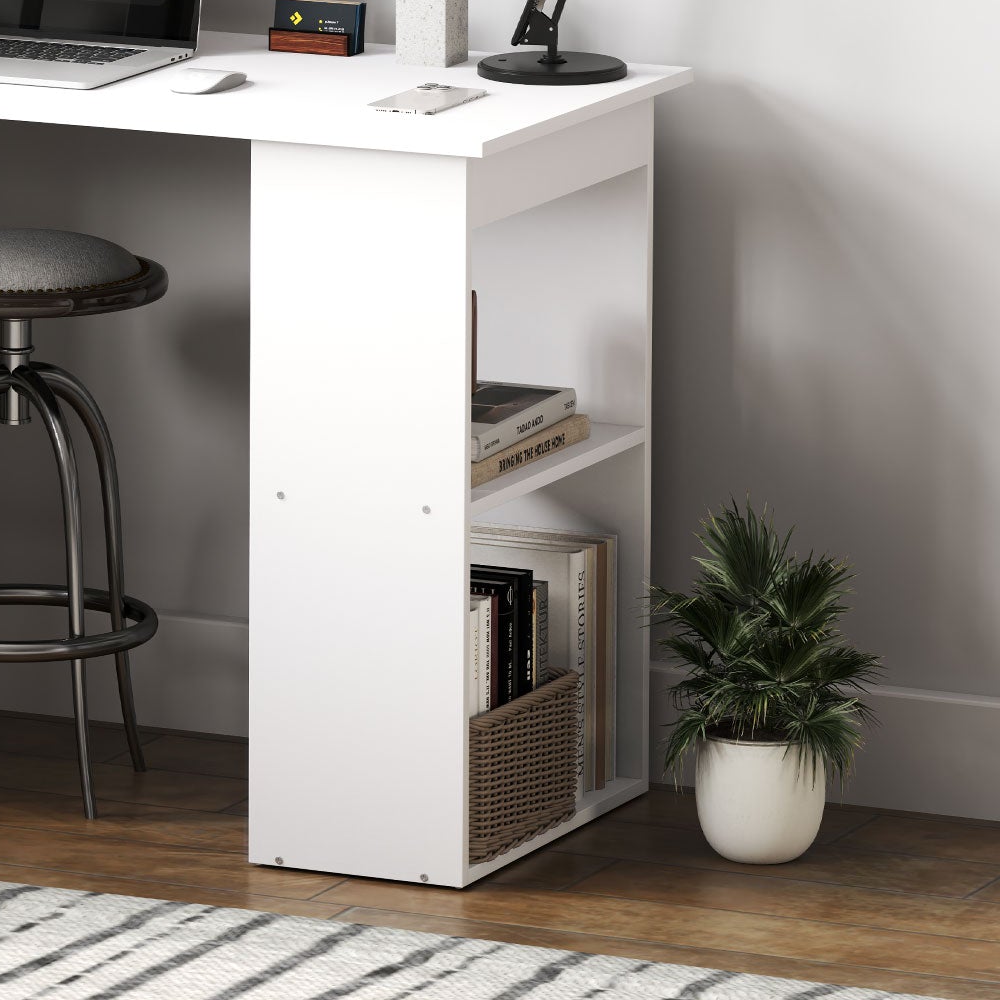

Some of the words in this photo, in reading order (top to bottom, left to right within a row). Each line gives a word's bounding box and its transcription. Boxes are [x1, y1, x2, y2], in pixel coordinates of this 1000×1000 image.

[516, 420, 531, 435] TADAO
[532, 414, 544, 427] ANDO
[499, 451, 522, 472] BRINGING
[524, 445, 534, 461] THE
[535, 440, 550, 457] HOUSE
[551, 433, 566, 449] HOME
